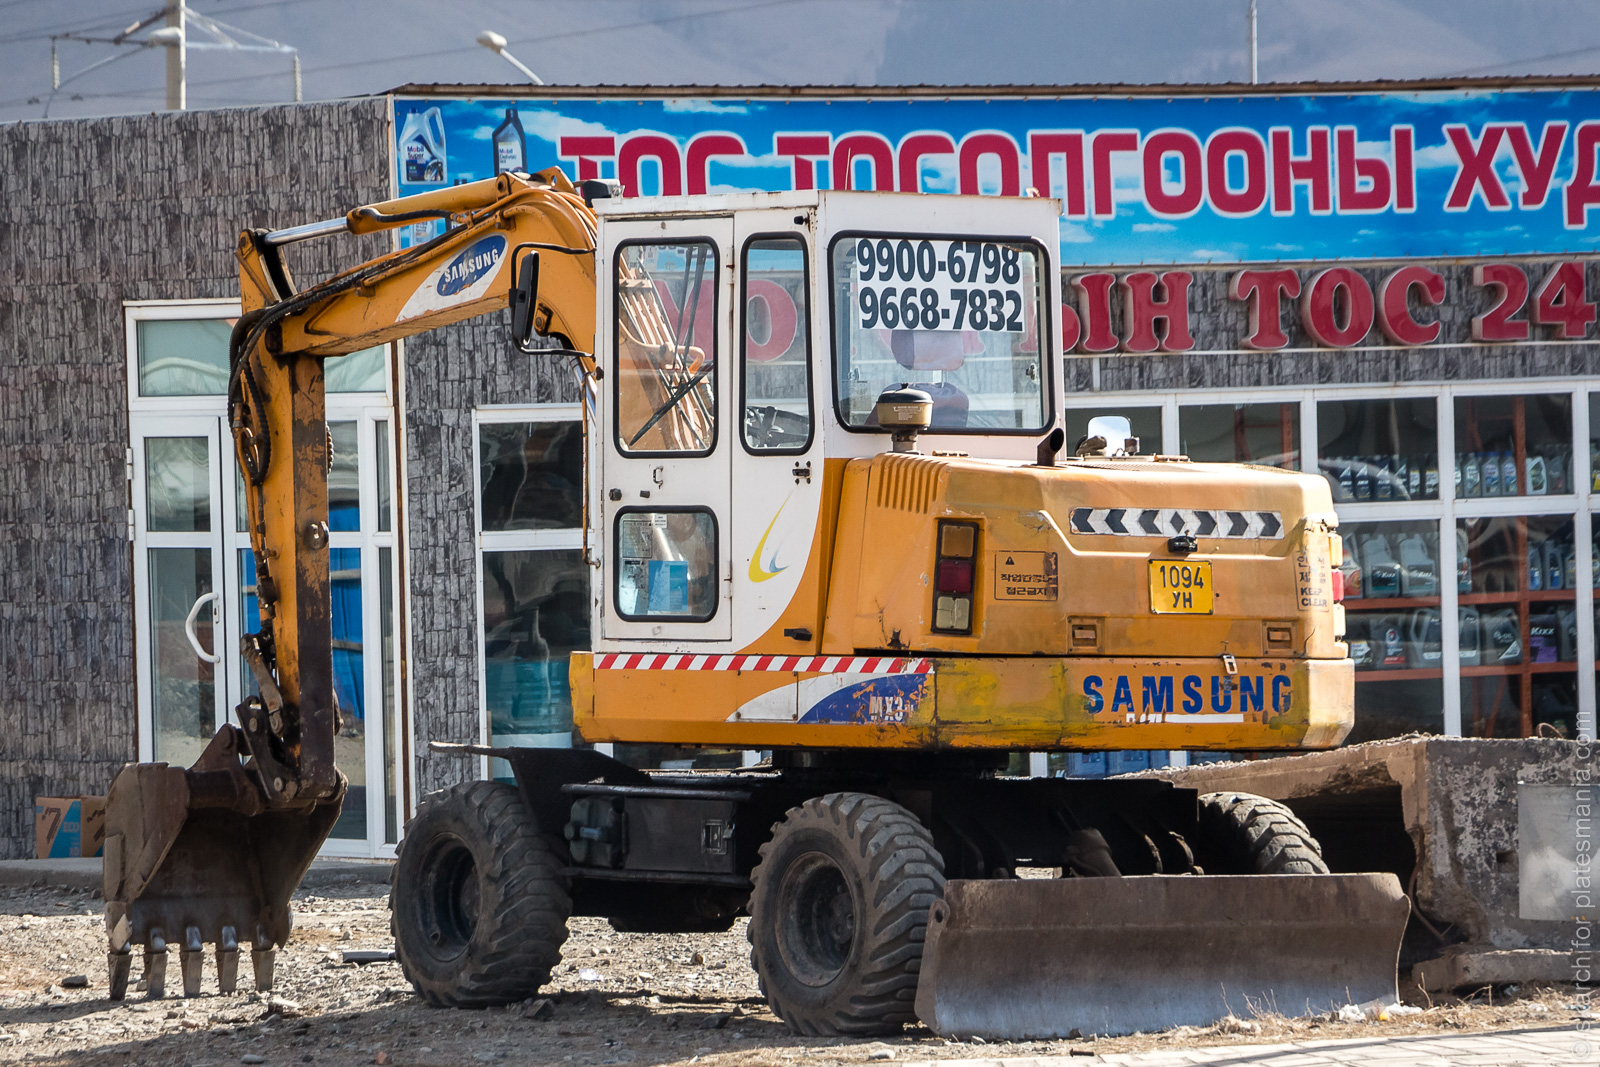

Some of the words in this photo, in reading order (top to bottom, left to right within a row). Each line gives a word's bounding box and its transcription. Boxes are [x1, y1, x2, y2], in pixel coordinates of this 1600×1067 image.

[407, 145, 425, 153] Mobil
[444, 248, 499, 283] SAMSUNG
[857, 238, 1021, 285] 9900-6798
[859, 286, 1024, 332] 9668-7832
[1230, 265, 1446, 349] ТОС
[1473, 262, 1598, 342] 24
[1160, 565, 1204, 589] 1094
[1172, 590, 1193, 609] УН
[1530, 627, 1556, 636] Kixx
[1083, 675, 1292, 714] SAMSUNG
